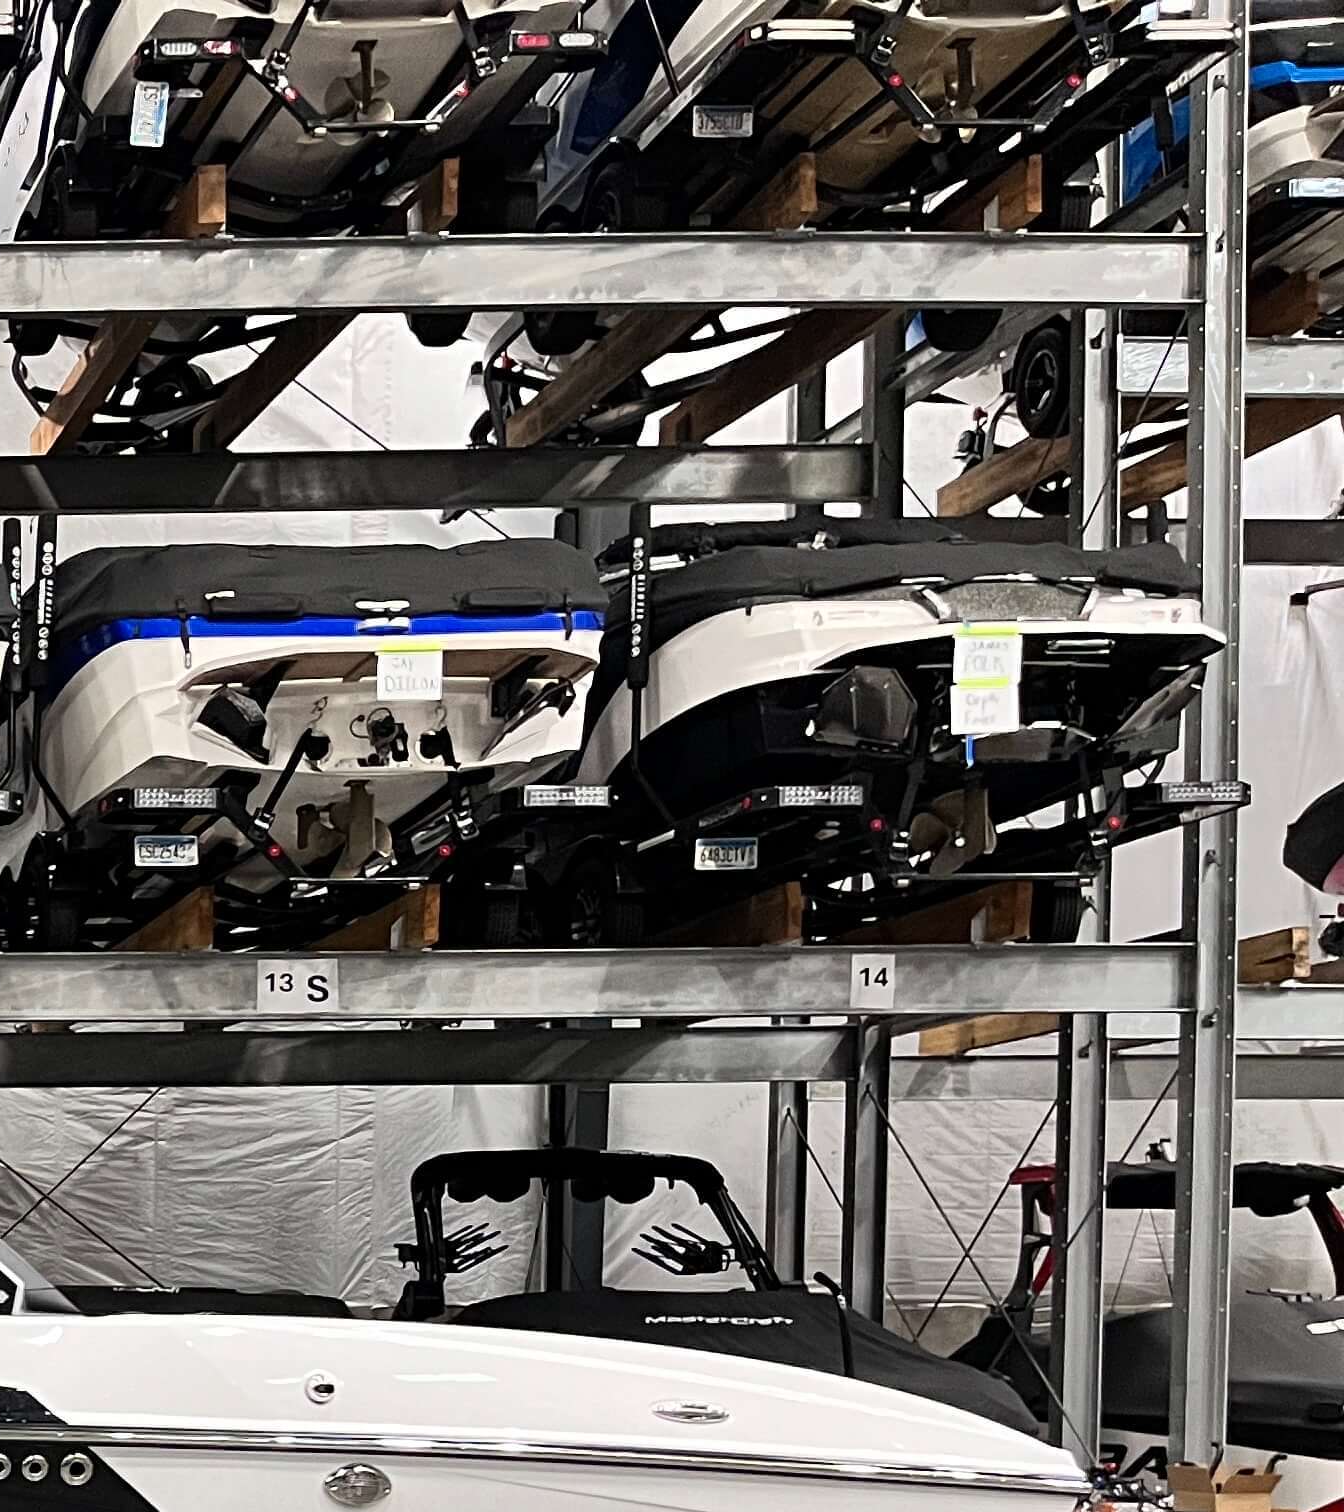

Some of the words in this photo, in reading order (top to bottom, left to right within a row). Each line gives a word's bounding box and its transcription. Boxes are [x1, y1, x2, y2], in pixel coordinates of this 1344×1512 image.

[265, 973, 294, 993] 13
[307, 975, 330, 1003] S
[859, 967, 889, 987] 14
